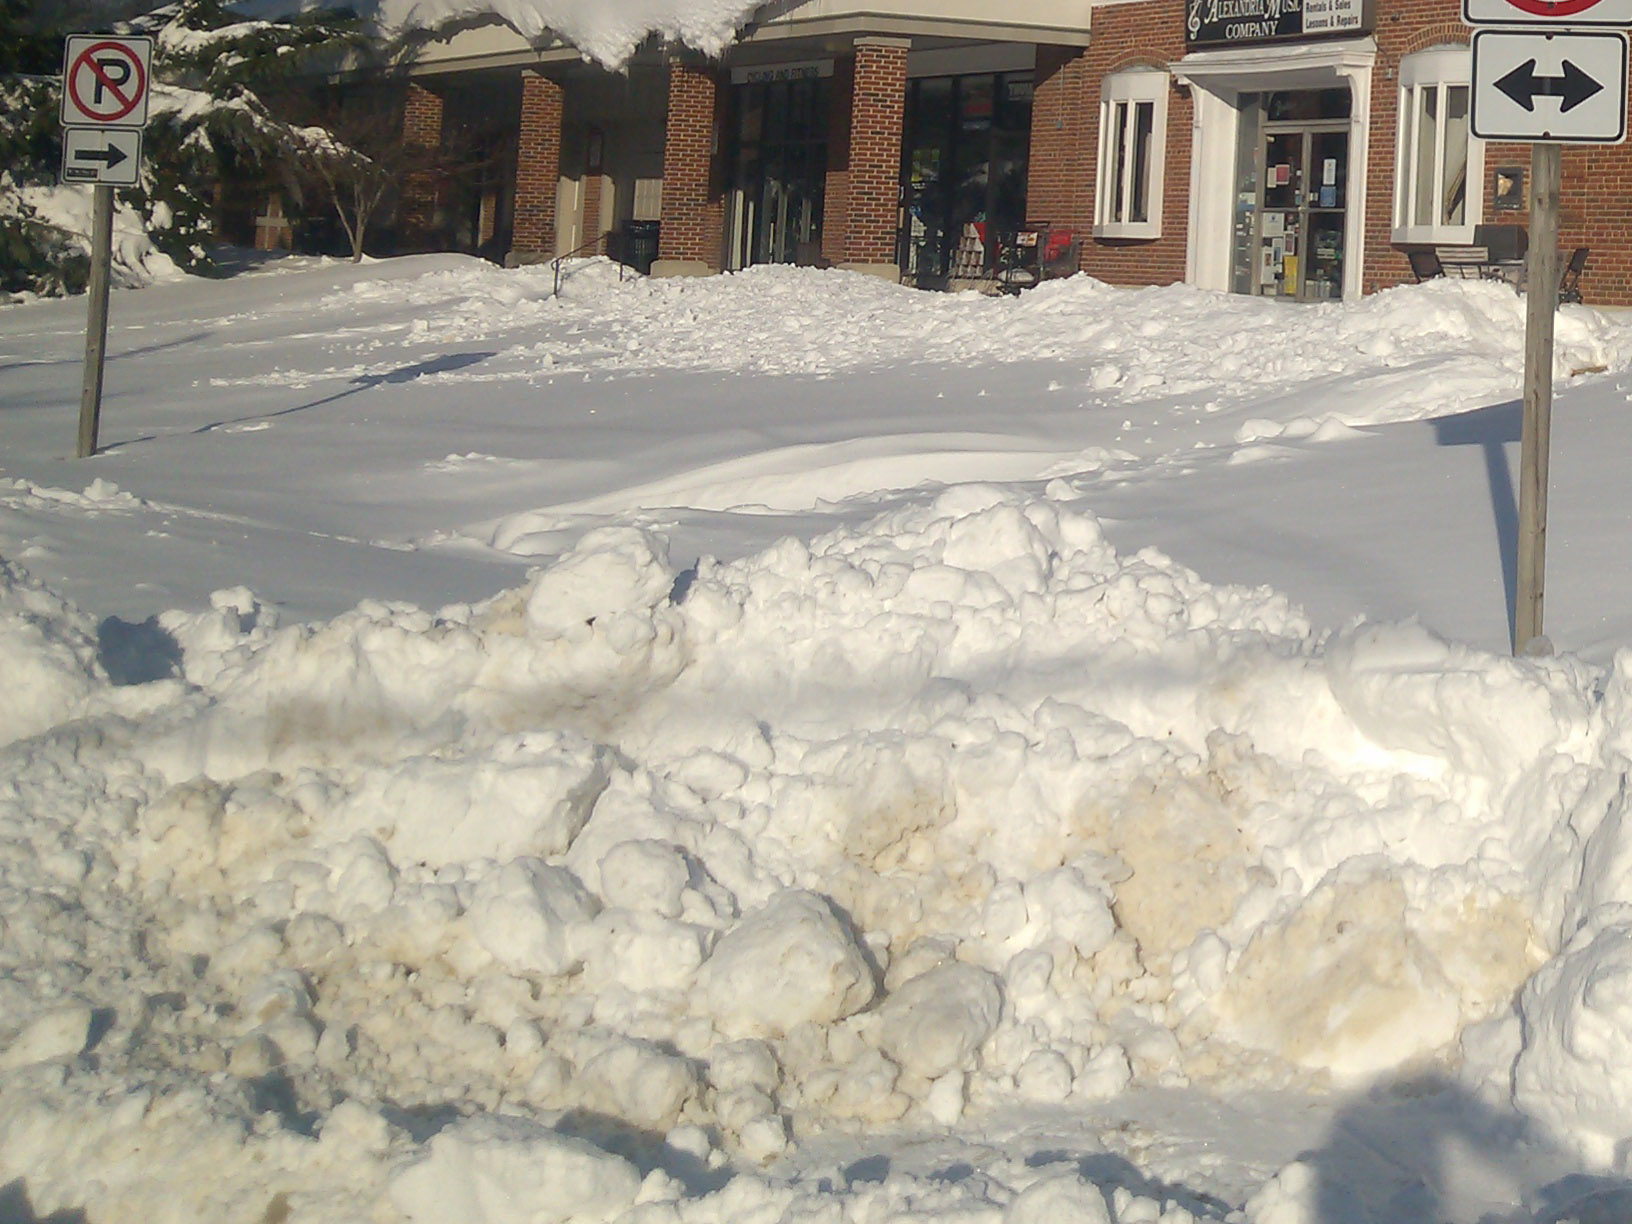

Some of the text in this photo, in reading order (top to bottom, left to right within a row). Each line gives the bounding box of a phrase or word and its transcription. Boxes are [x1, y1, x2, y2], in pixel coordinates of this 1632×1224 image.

[1306, 1, 1327, 14] Rentals
[1305, 17, 1328, 29] Lessons
[1336, 14, 1359, 27] Repairs
[1225, 20, 1279, 39] COMPANY
